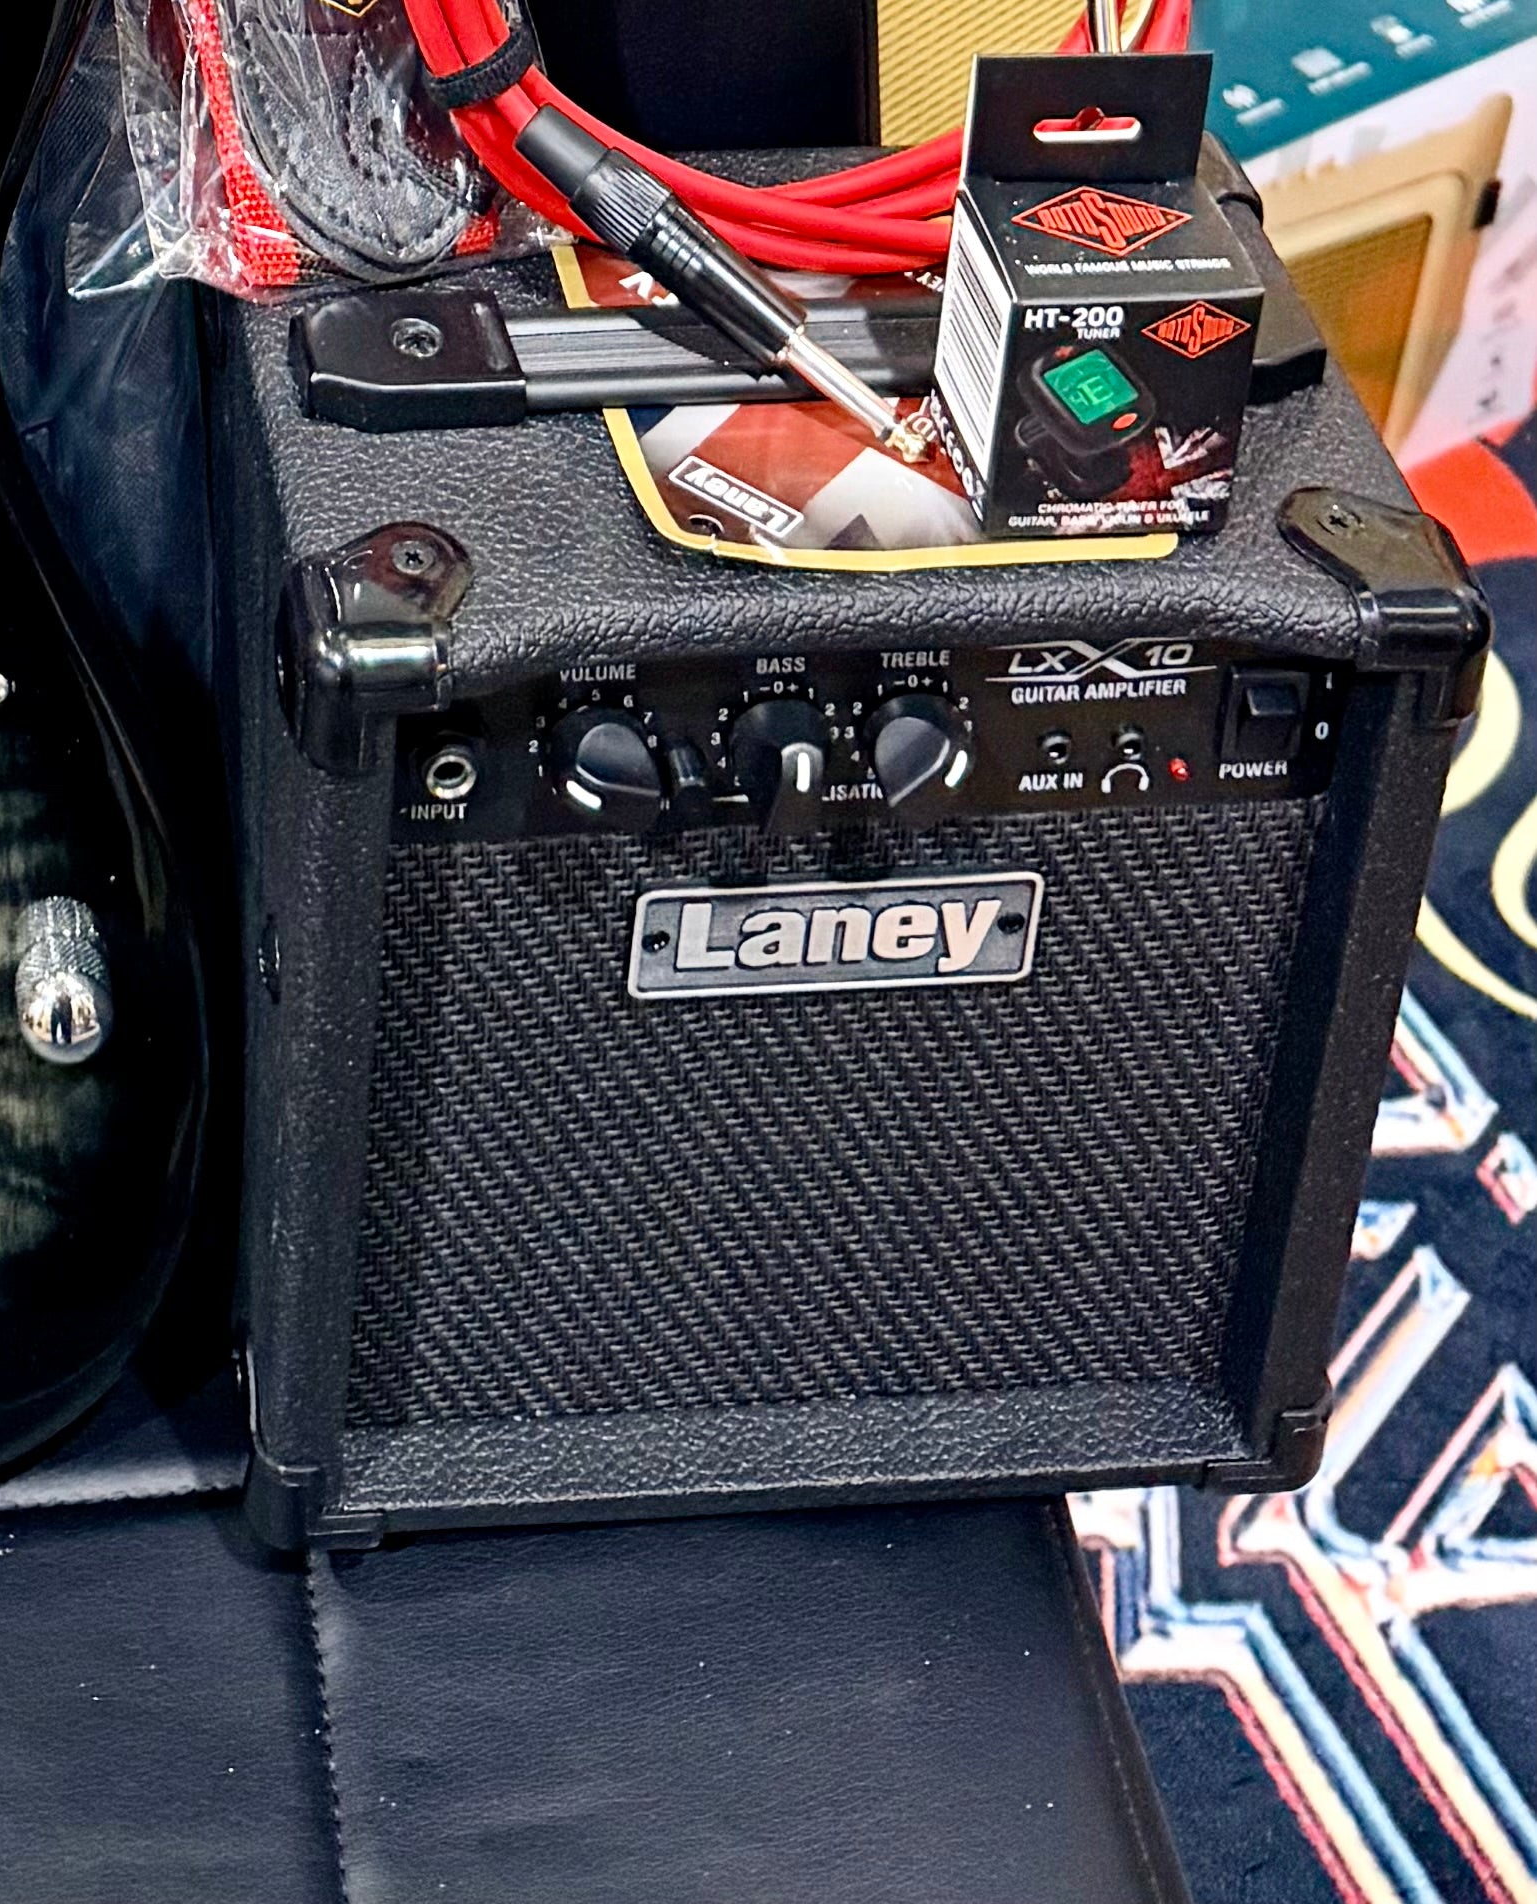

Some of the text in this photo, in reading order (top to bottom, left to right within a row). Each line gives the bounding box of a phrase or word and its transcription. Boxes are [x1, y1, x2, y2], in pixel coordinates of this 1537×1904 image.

[1024, 257, 1231, 275] WORLD FAMOUS MUSIC STRINGS
[1023, 305, 1125, 330] HT-200
[1076, 327, 1121, 340] TUNER
[687, 462, 789, 533] Laney
[755, 656, 806, 675] BASS
[880, 649, 951, 669] TREBLE
[1010, 678, 1188, 706] GUITAR AMPLIFIER
[1218, 759, 1289, 780] POWER
[1018, 771, 1084, 792] AUX IN
[410, 803, 468, 821] INPUT
[673, 898, 1003, 974] Laney
